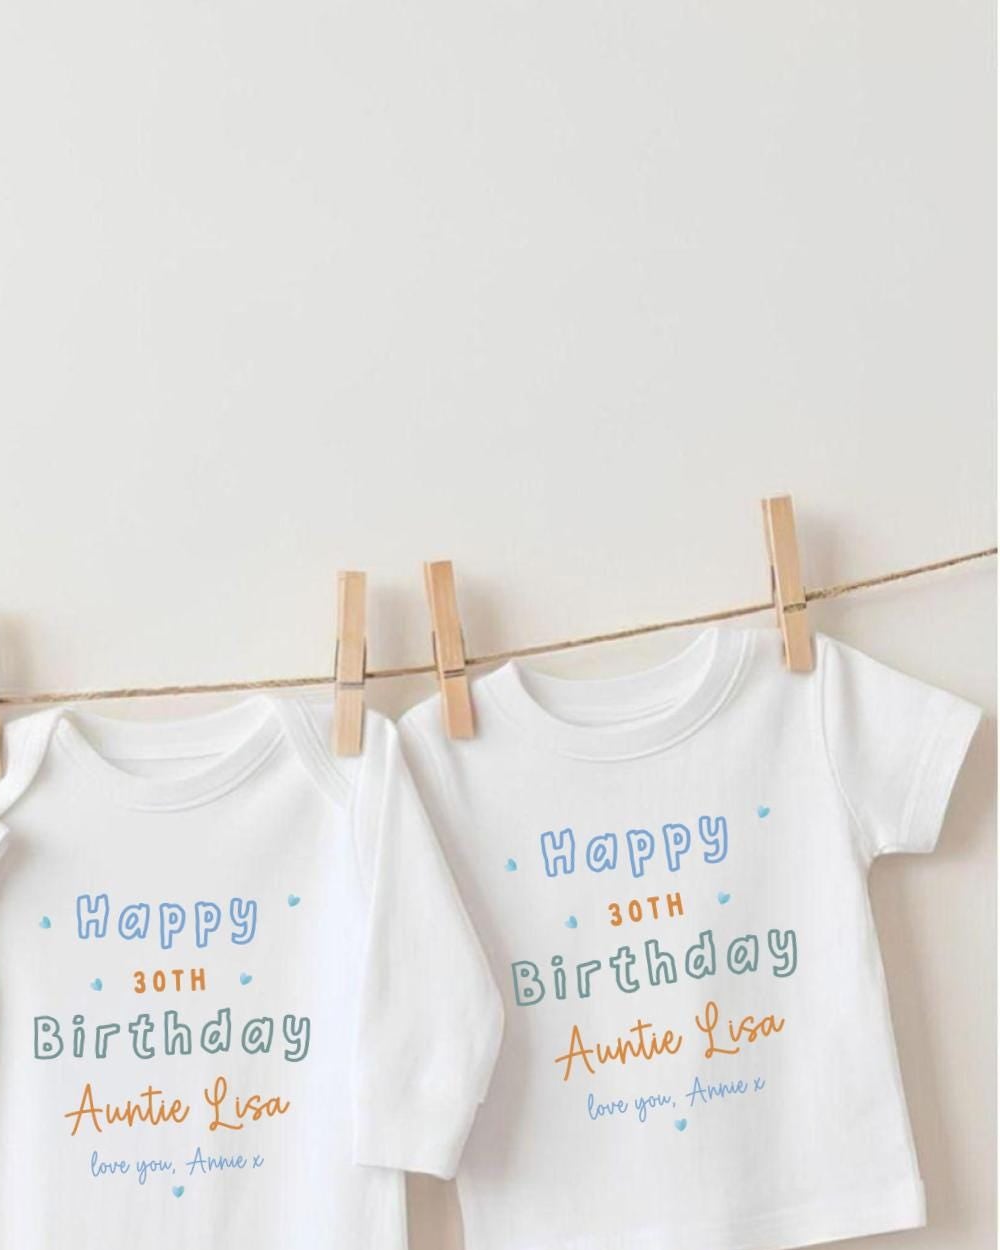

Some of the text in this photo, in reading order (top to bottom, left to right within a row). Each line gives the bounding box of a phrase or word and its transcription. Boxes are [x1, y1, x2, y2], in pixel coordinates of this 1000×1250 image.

[540, 815, 728, 878] Happy
[76, 893, 257, 950] Happy
[608, 892, 684, 928] 30TH
[133, 967, 206, 994] 30TH
[510, 929, 798, 1008] Birthday
[34, 1007, 311, 1062] Birthday
[554, 1001, 785, 1082] Auntie Lisa
[64, 1076, 291, 1136] Auntie Lisa
[588, 1076, 765, 1123] love you, Annie x
[91, 1147, 264, 1185] love you, Annie x
